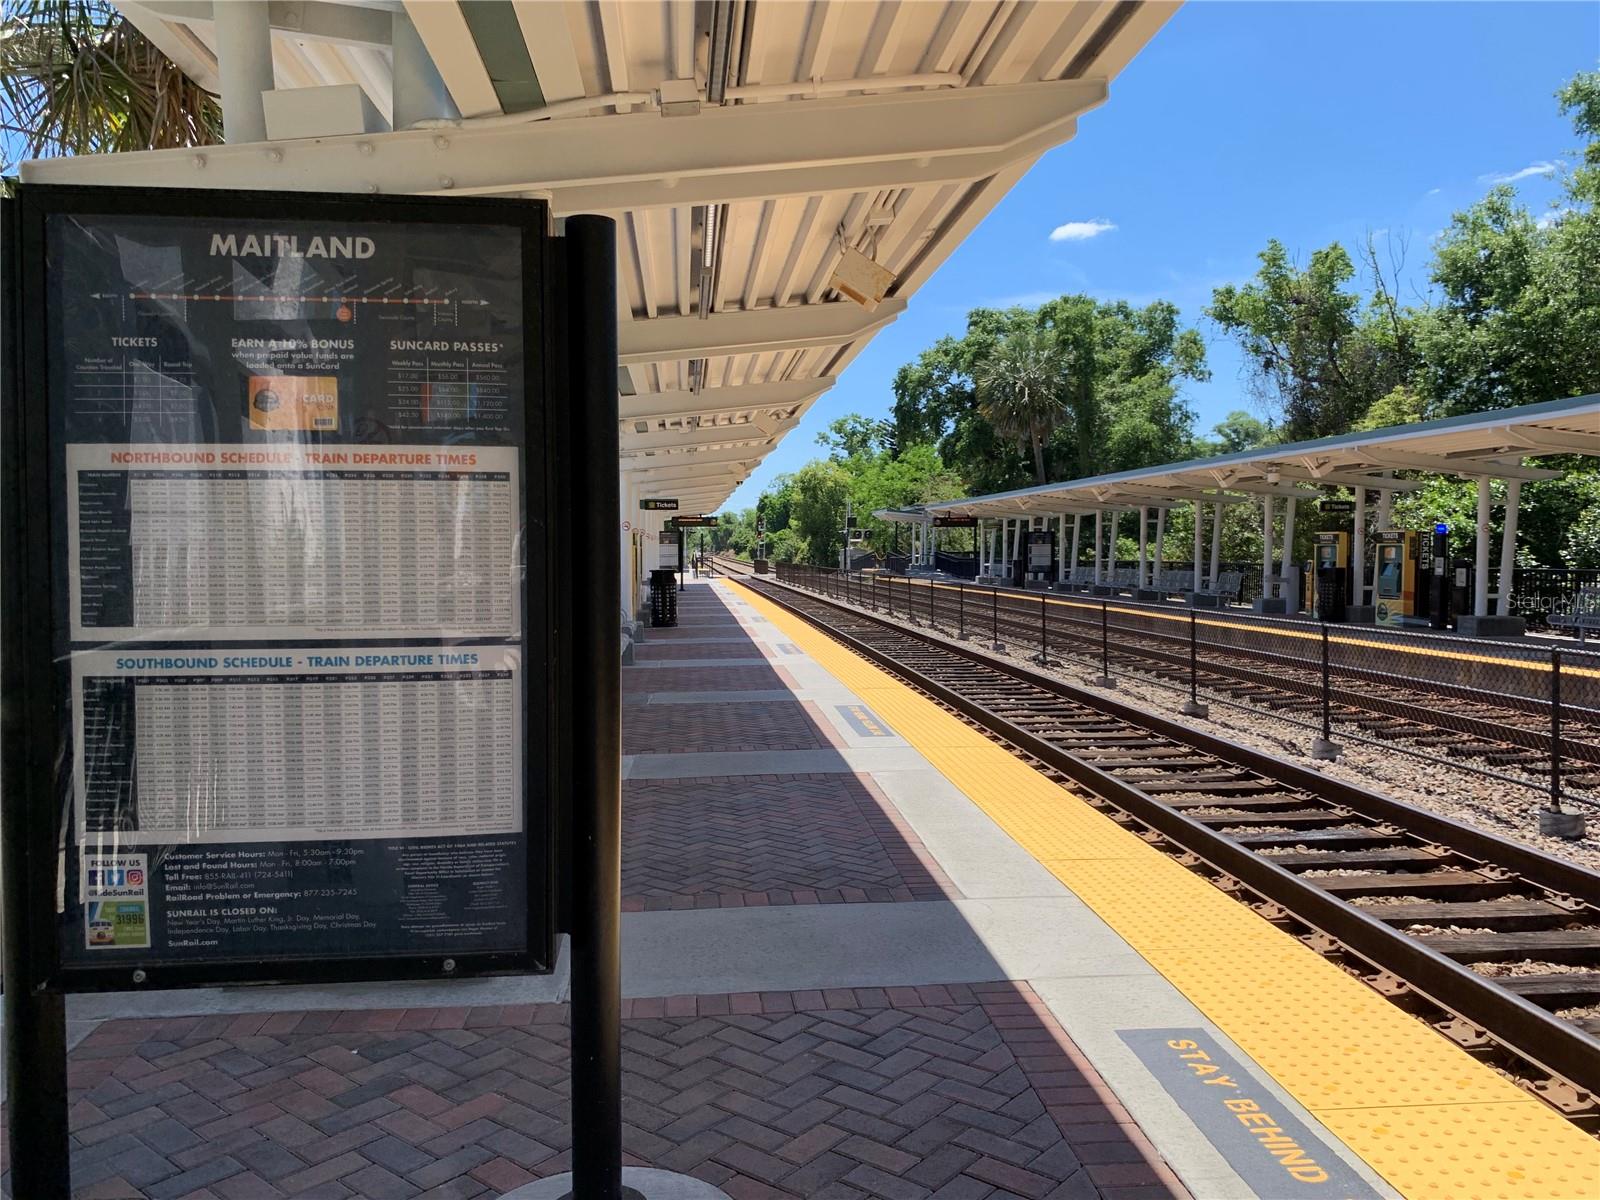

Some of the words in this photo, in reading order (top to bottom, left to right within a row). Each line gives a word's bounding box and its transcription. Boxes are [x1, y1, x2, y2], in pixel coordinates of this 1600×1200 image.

[209, 233, 376, 259] MAITLAND
[111, 336, 158, 347] TICKETS
[231, 338, 264, 348] EARN
[311, 339, 355, 349] BONUS
[389, 340, 450, 351] SUNCARD
[231, 351, 255, 359] when
[256, 351, 289, 360] prepaid
[291, 351, 314, 359] value
[315, 351, 338, 360] funds
[246, 362, 275, 370] loaded
[277, 362, 296, 370] onto
[305, 362, 340, 370] SunCard
[303, 393, 334, 403] CARD
[111, 452, 216, 465] NORTHBOUND
[220, 452, 291, 465] SCHEDULE
[305, 452, 348, 465] TRAIN
[352, 453, 432, 465] DEPARTURE
[436, 453, 477, 466] TIMES
[1421, 532, 1430, 570] TICKETS
[116, 657, 218, 670] SOUTHBOUND
[223, 656, 293, 668] SCHEDULE
[307, 655, 350, 667] TRAIN
[355, 654, 433, 667] DEPARTURE
[438, 653, 478, 665] TIMES
[164, 852, 204, 861] Customer
[205, 851, 236, 860] Service
[238, 851, 266, 859] Hours:
[268, 850, 284, 858] Mon
[164, 863, 181, 871] Lost
[183, 862, 200, 870] and
[202, 862, 228, 870] Found
[230, 861, 257, 869] Hours:
[164, 873, 179, 881] Toll
[181, 873, 202, 881] Free:
[165, 883, 191, 891] Email:
[166, 893, 203, 902] RailRoad
[205, 892, 240, 900] Problem
[254, 891, 302, 900] Emergency:
[166, 909, 207, 918] SUNRAIL
[221, 907, 256, 916] CLOSED
[259, 906, 278, 915] ON:
[223, 917, 246, 925] Martin
[313, 913, 345, 921] Memorial
[168, 938, 219, 947] SunRail.com
[1167, 1038, 1238, 1088] STAY
[1223, 1098, 1329, 1184] BEHIND
